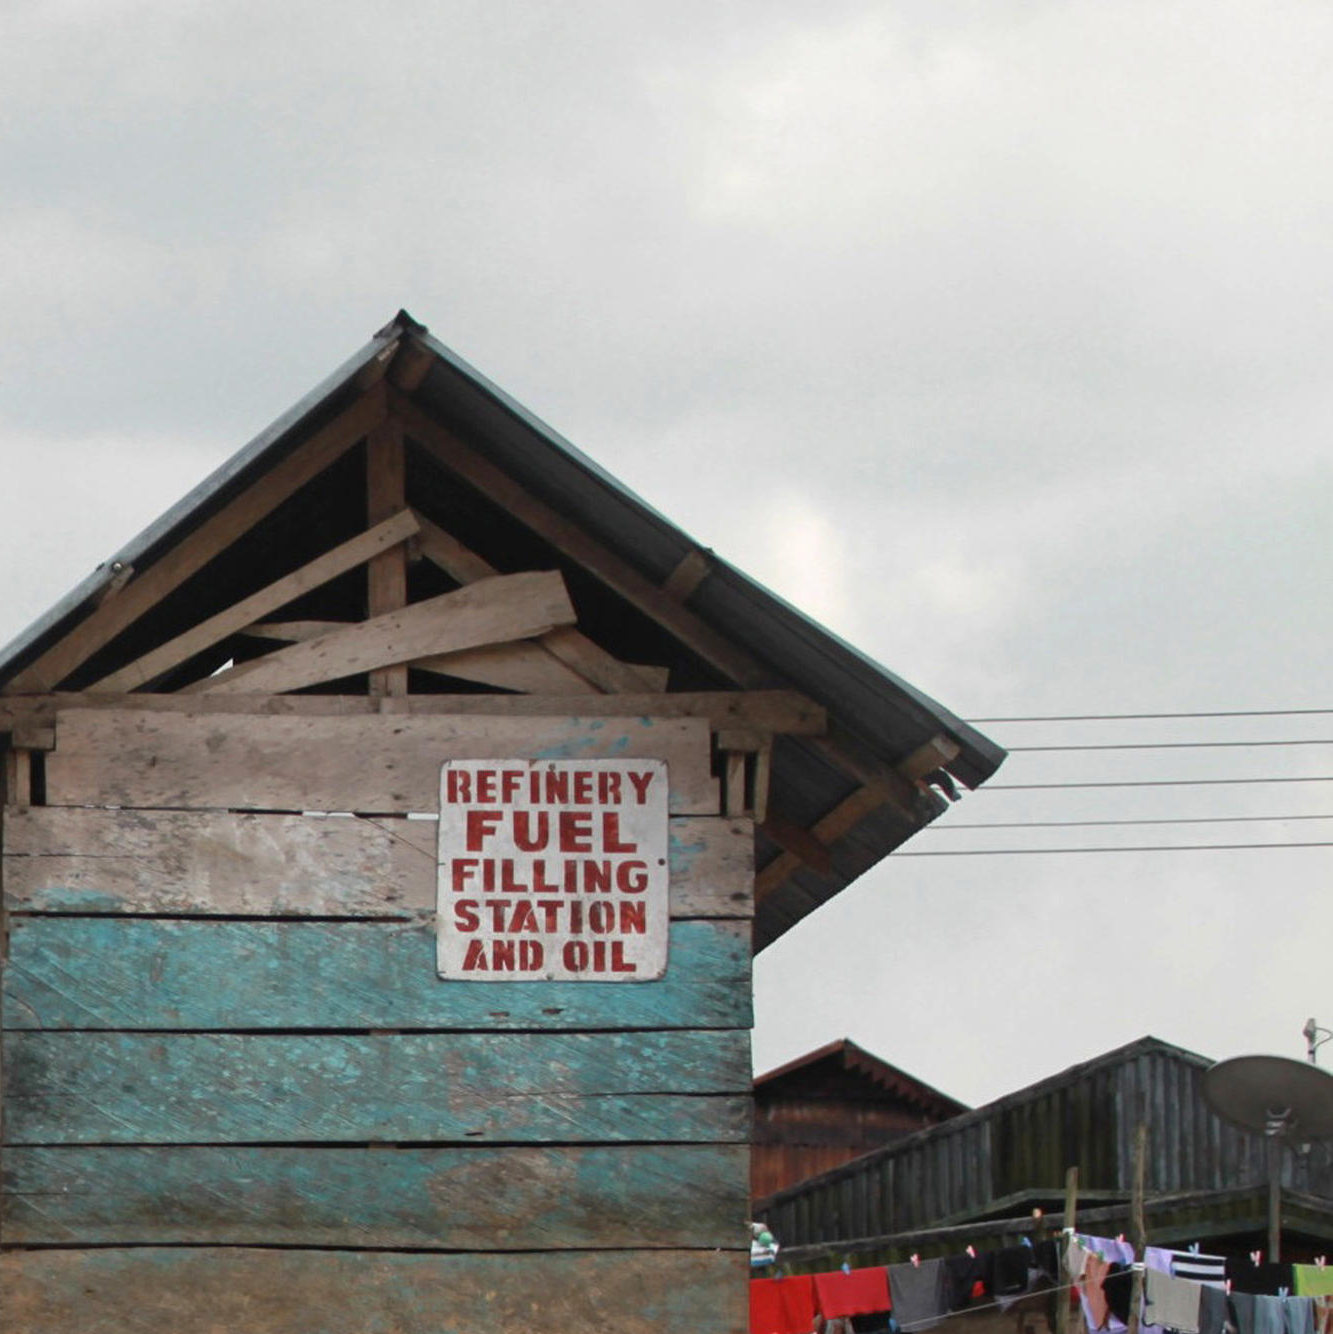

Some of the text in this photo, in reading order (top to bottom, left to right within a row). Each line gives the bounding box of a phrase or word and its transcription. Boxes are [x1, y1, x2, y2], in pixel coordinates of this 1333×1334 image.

[447, 770, 654, 805] REFINERY
[466, 811, 637, 853] FUEL
[451, 858, 649, 894] FILLING
[454, 899, 646, 934] STATION
[462, 939, 637, 973] AND OIL
